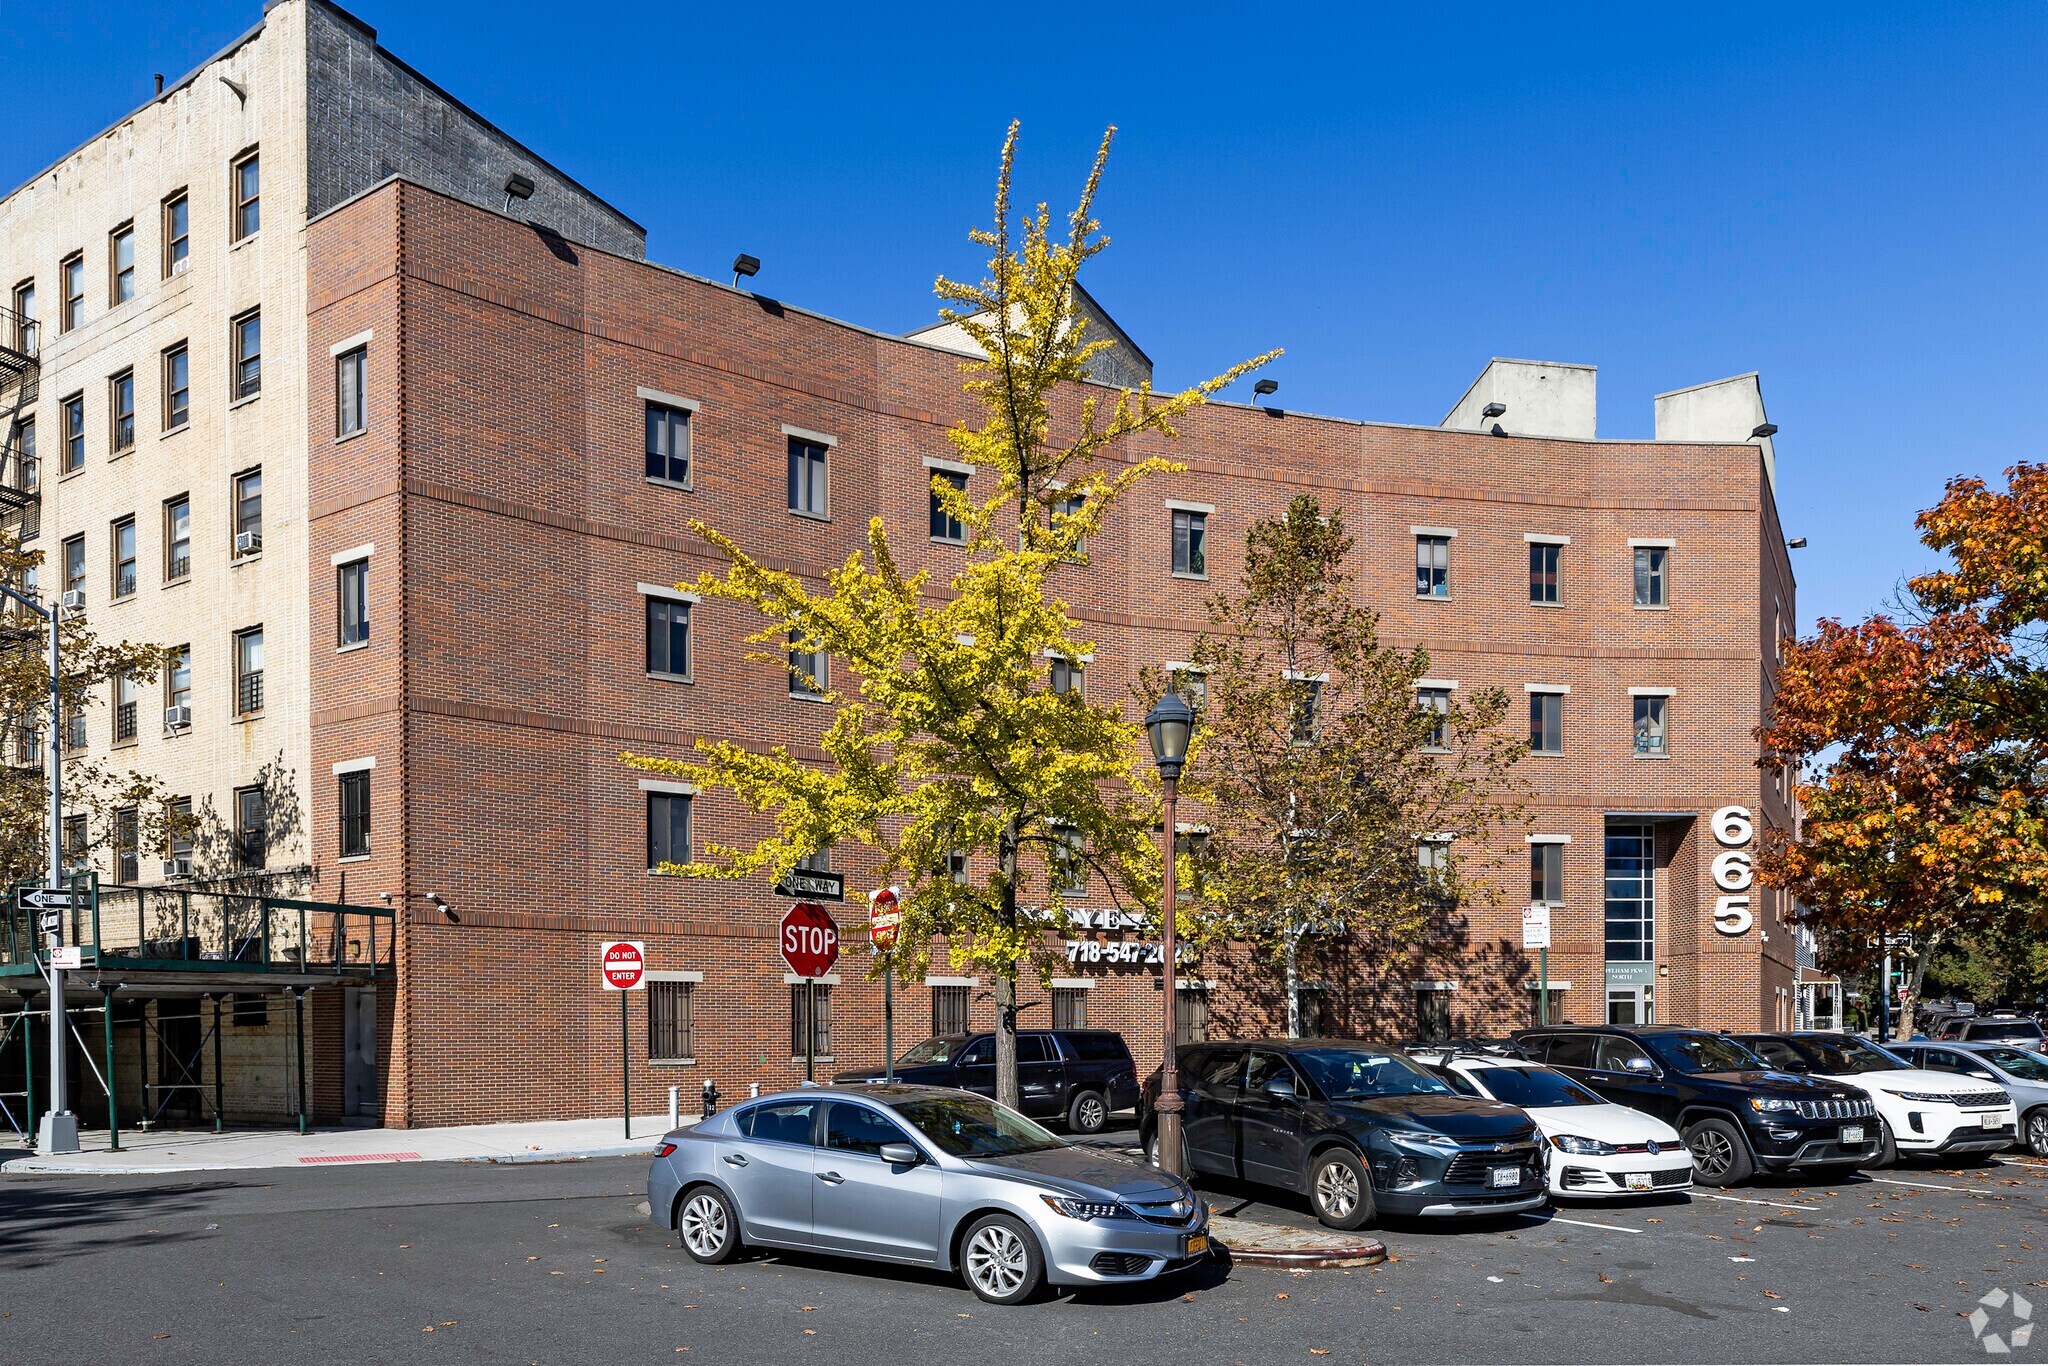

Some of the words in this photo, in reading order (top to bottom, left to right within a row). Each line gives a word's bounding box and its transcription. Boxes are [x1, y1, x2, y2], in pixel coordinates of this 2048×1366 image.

[1711, 805, 1753, 934] 665
[785, 875, 806, 889] ONE
[815, 880, 836, 893] WAY
[34, 894, 55, 903] ONE
[65, 895, 86, 904] WY
[785, 924, 837, 955] STOP
[610, 951, 620, 960] DO
[622, 951, 637, 960] NOT
[611, 971, 636, 980] ENTER
